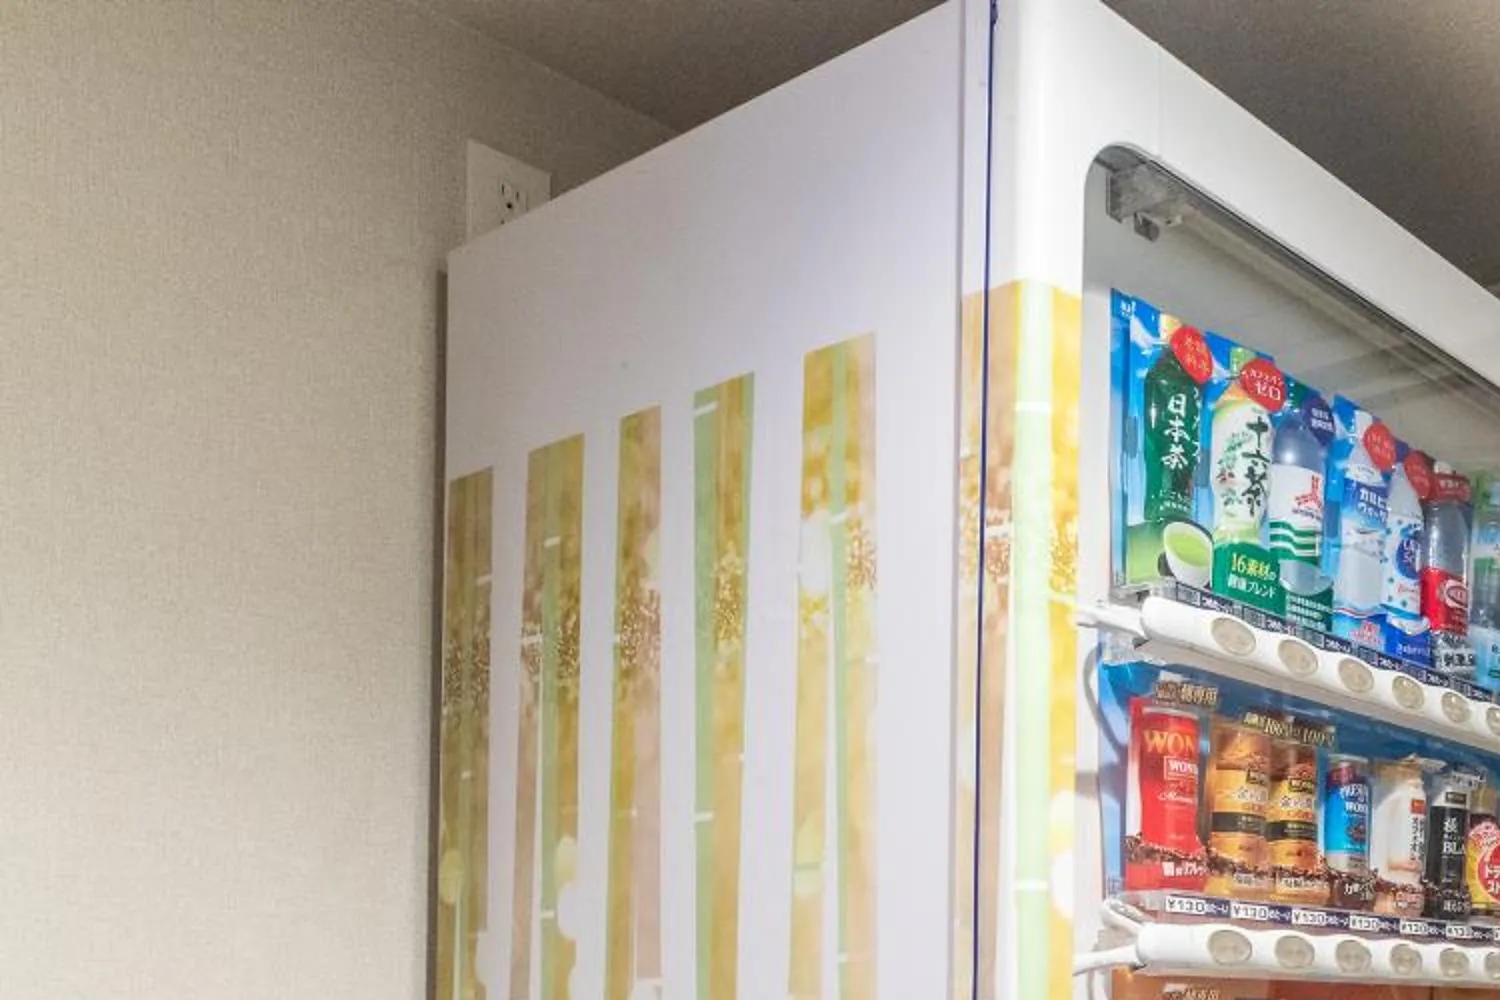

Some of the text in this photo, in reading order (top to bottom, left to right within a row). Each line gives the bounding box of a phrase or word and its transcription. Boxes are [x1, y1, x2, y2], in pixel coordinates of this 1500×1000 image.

[1254, 380, 1281, 401] ゼロ
[1163, 392, 1191, 470] 日本茶
